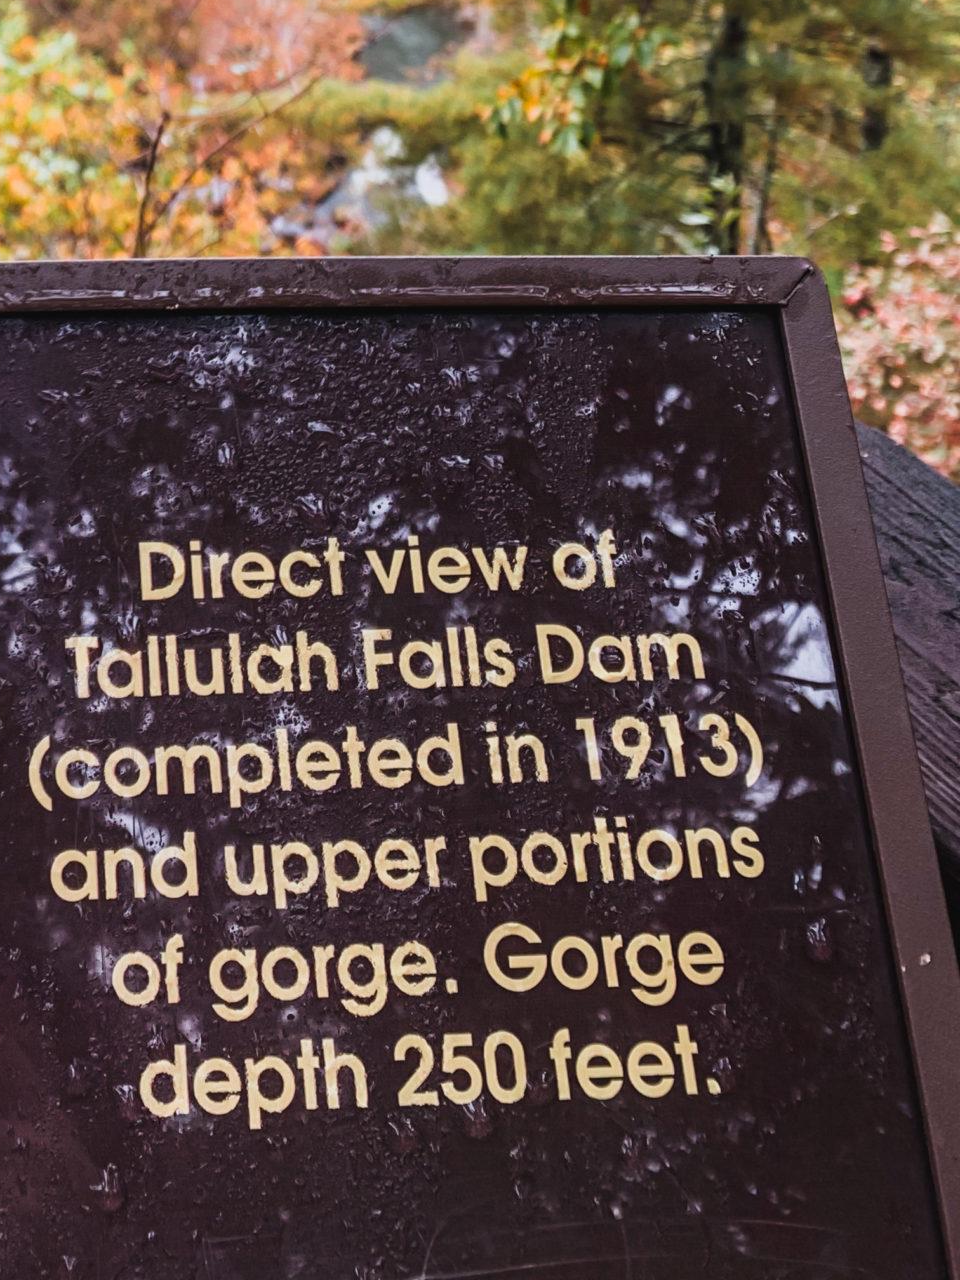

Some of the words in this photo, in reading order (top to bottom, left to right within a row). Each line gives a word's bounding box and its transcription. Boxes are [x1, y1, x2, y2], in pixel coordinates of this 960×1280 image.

[138, 537, 346, 601] Direct
[365, 535, 528, 596] view
[552, 529, 616, 591] of
[64, 634, 339, 699] Tallulah
[363, 627, 517, 691] Falls
[536, 624, 706, 684] Dam
[28, 726, 465, 811] (completed
[488, 724, 549, 784] in
[575, 713, 763, 787] 1913)
[50, 832, 199, 902] and
[224, 838, 448, 909] upper
[468, 816, 764, 902] portions
[112, 934, 183, 1007] of
[209, 939, 458, 1021] gorge.
[483, 922, 725, 1006] Gorge
[139, 1038, 368, 1129] depth
[394, 1030, 526, 1107] 250
[550, 1025, 722, 1101] feet.
